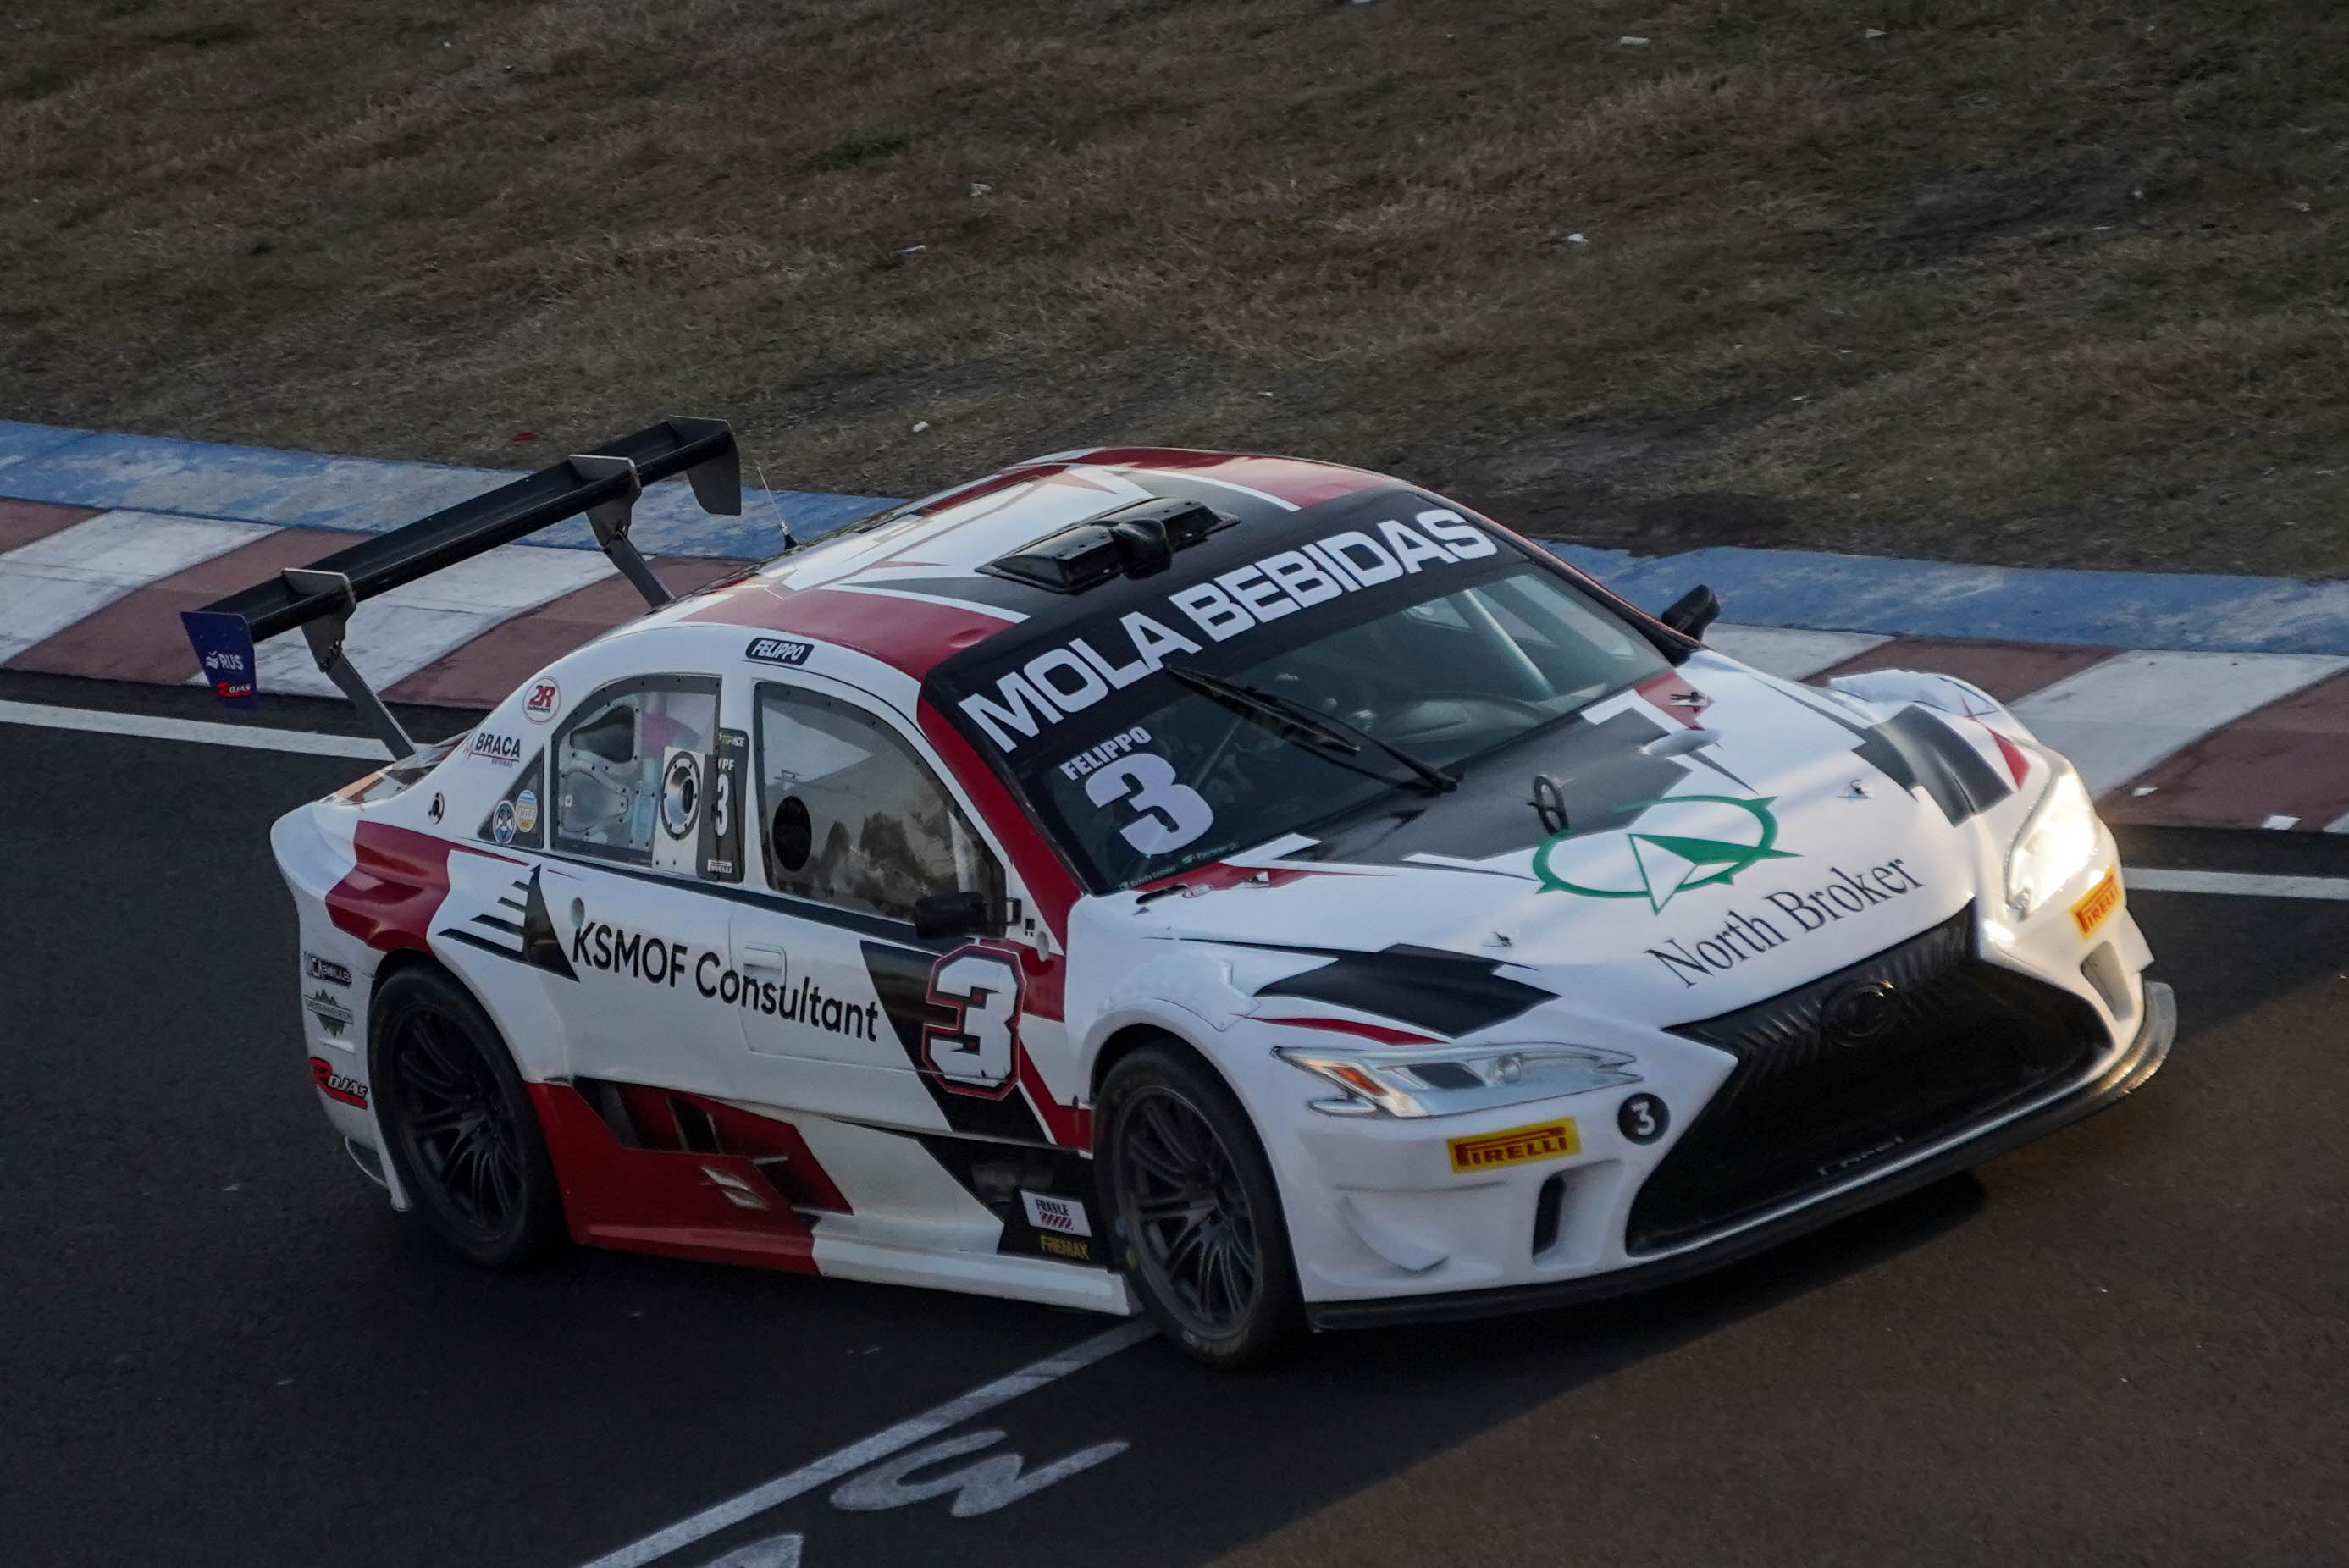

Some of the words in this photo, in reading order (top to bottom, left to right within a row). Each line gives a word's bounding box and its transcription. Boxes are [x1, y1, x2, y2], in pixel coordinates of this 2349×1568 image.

[751, 639, 805, 661] FELIPPO
[958, 610, 1202, 754] MOLA
[1168, 509, 1498, 643] BEBIDAS
[218, 653, 244, 671] RUS
[528, 684, 556, 708] 2R
[475, 732, 521, 758] BRACA
[1059, 726, 1152, 781] FELIPPO
[716, 774, 729, 836] 3
[1085, 753, 1214, 855] 3
[707, 859, 732, 874] PIRELLI
[1643, 909, 1791, 988] North
[1762, 858, 1926, 934] Broker
[2074, 873, 2120, 934] PIRELLI
[572, 921, 687, 988] KSMOF
[695, 952, 880, 1044] Consultant
[921, 942, 1027, 1100] 3
[310, 1056, 369, 1111] ROJAS
[1631, 1100, 1657, 1136] 3
[1453, 1125, 1568, 1167] PIRELLI
